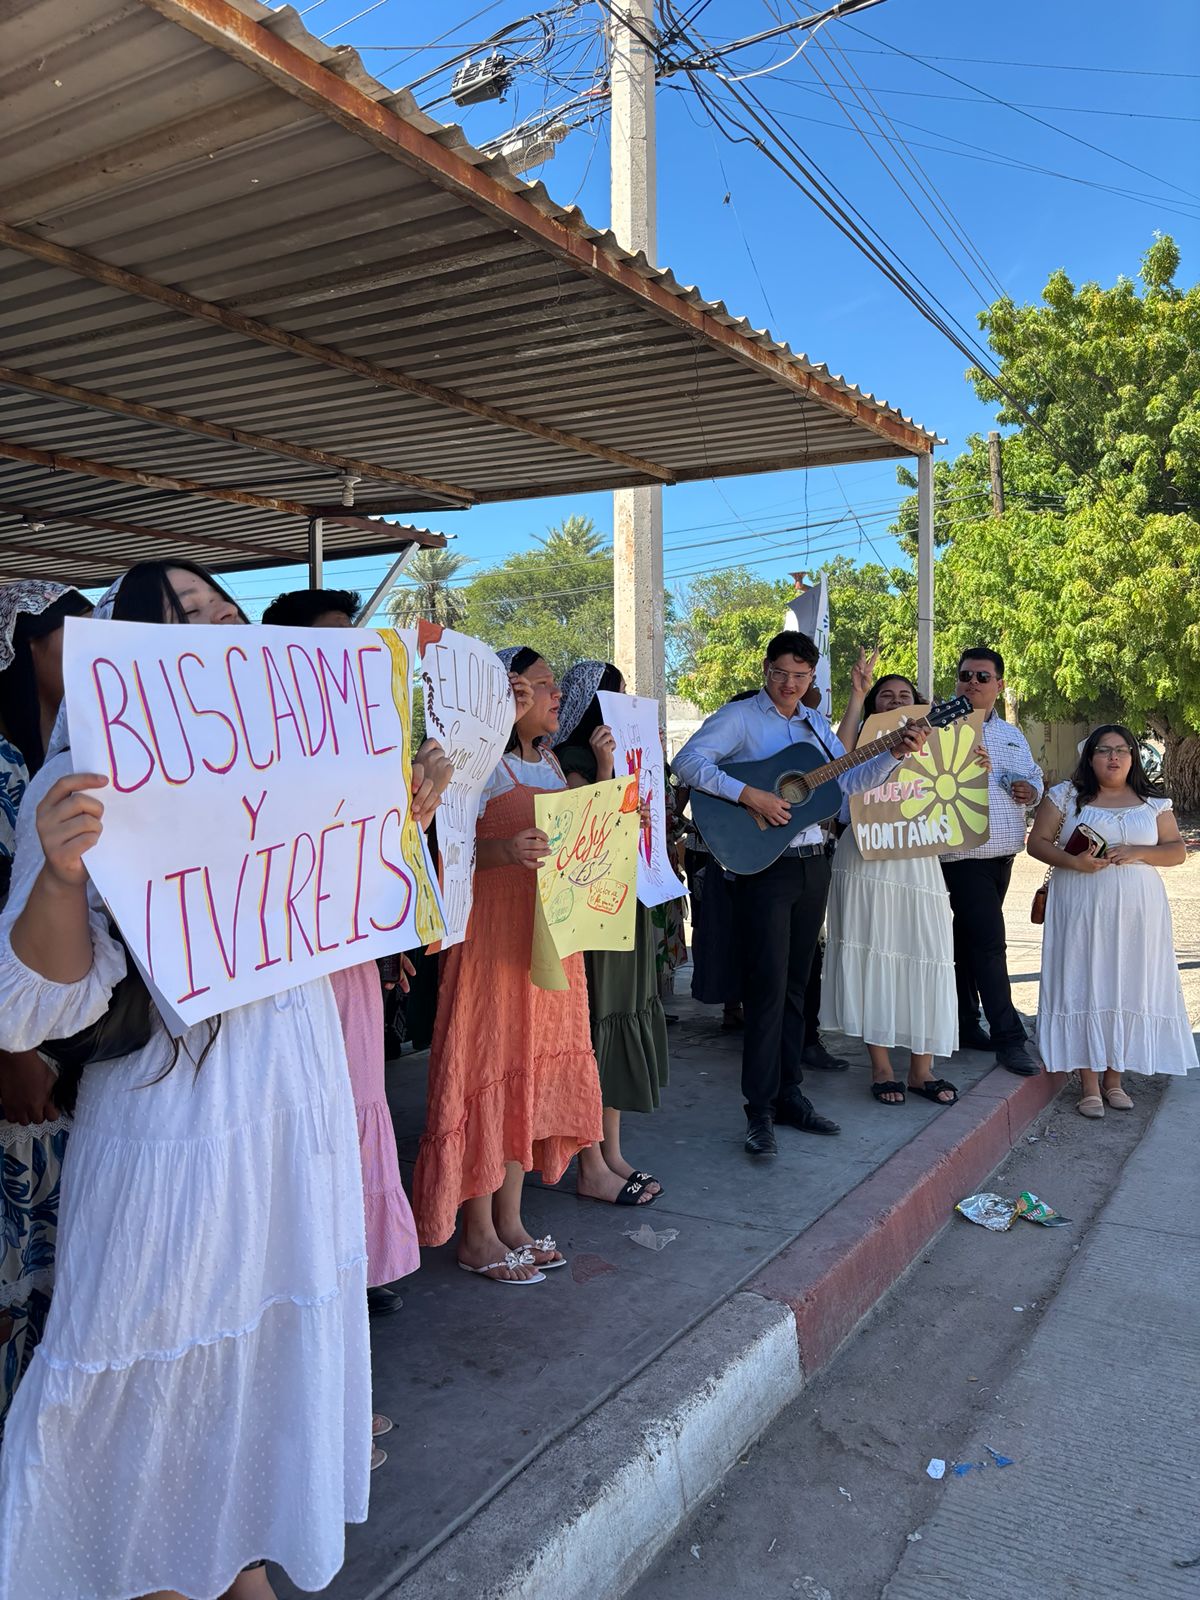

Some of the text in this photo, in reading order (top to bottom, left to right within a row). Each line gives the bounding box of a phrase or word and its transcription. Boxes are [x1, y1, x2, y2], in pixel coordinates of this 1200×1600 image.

[435, 644, 466, 712] EL
[91, 643, 398, 793] BUSCADME
[863, 778, 928, 806] MUEVE
[241, 790, 268, 842] Y
[857, 814, 954, 851] MONTAÑAS
[575, 860, 596, 882] ES
